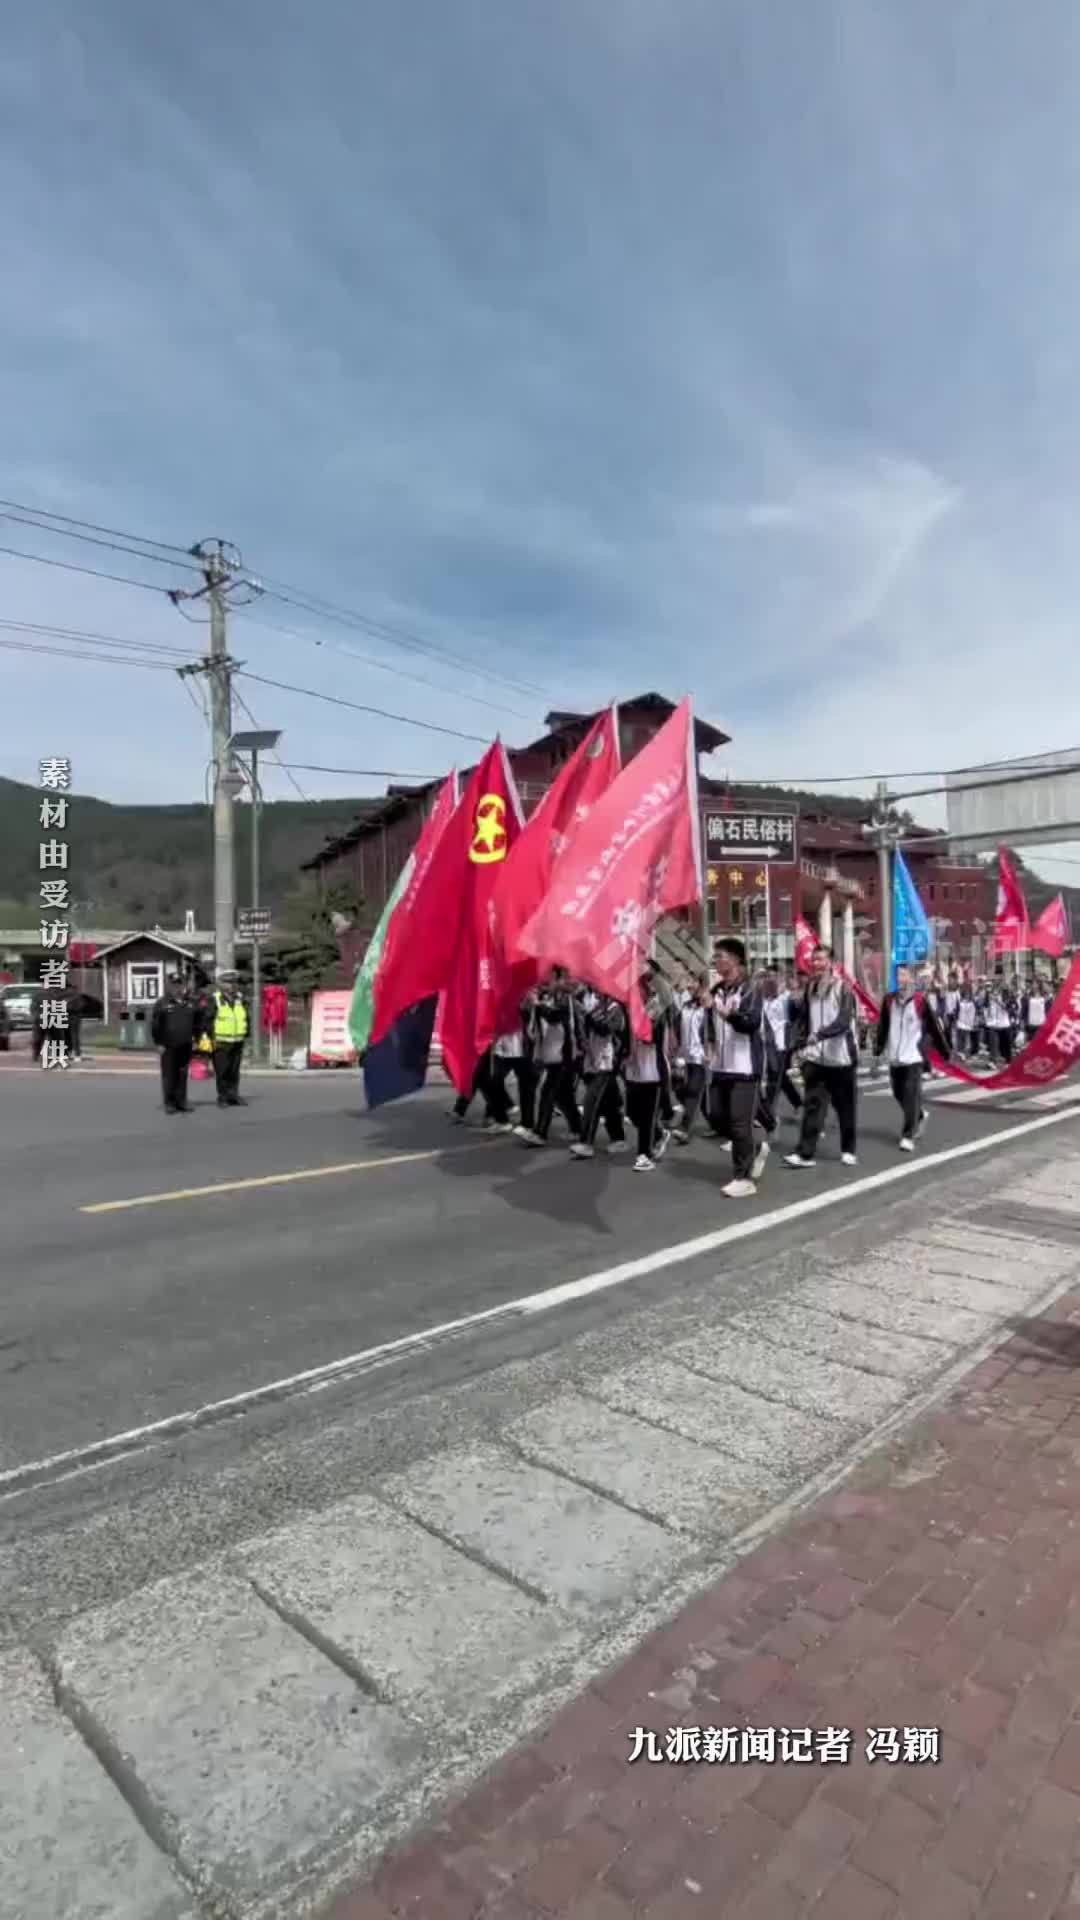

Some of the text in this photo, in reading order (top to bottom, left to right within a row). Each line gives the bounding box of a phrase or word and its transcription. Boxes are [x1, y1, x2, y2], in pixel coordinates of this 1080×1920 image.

[708, 815, 793, 841] 偏石民俗村
